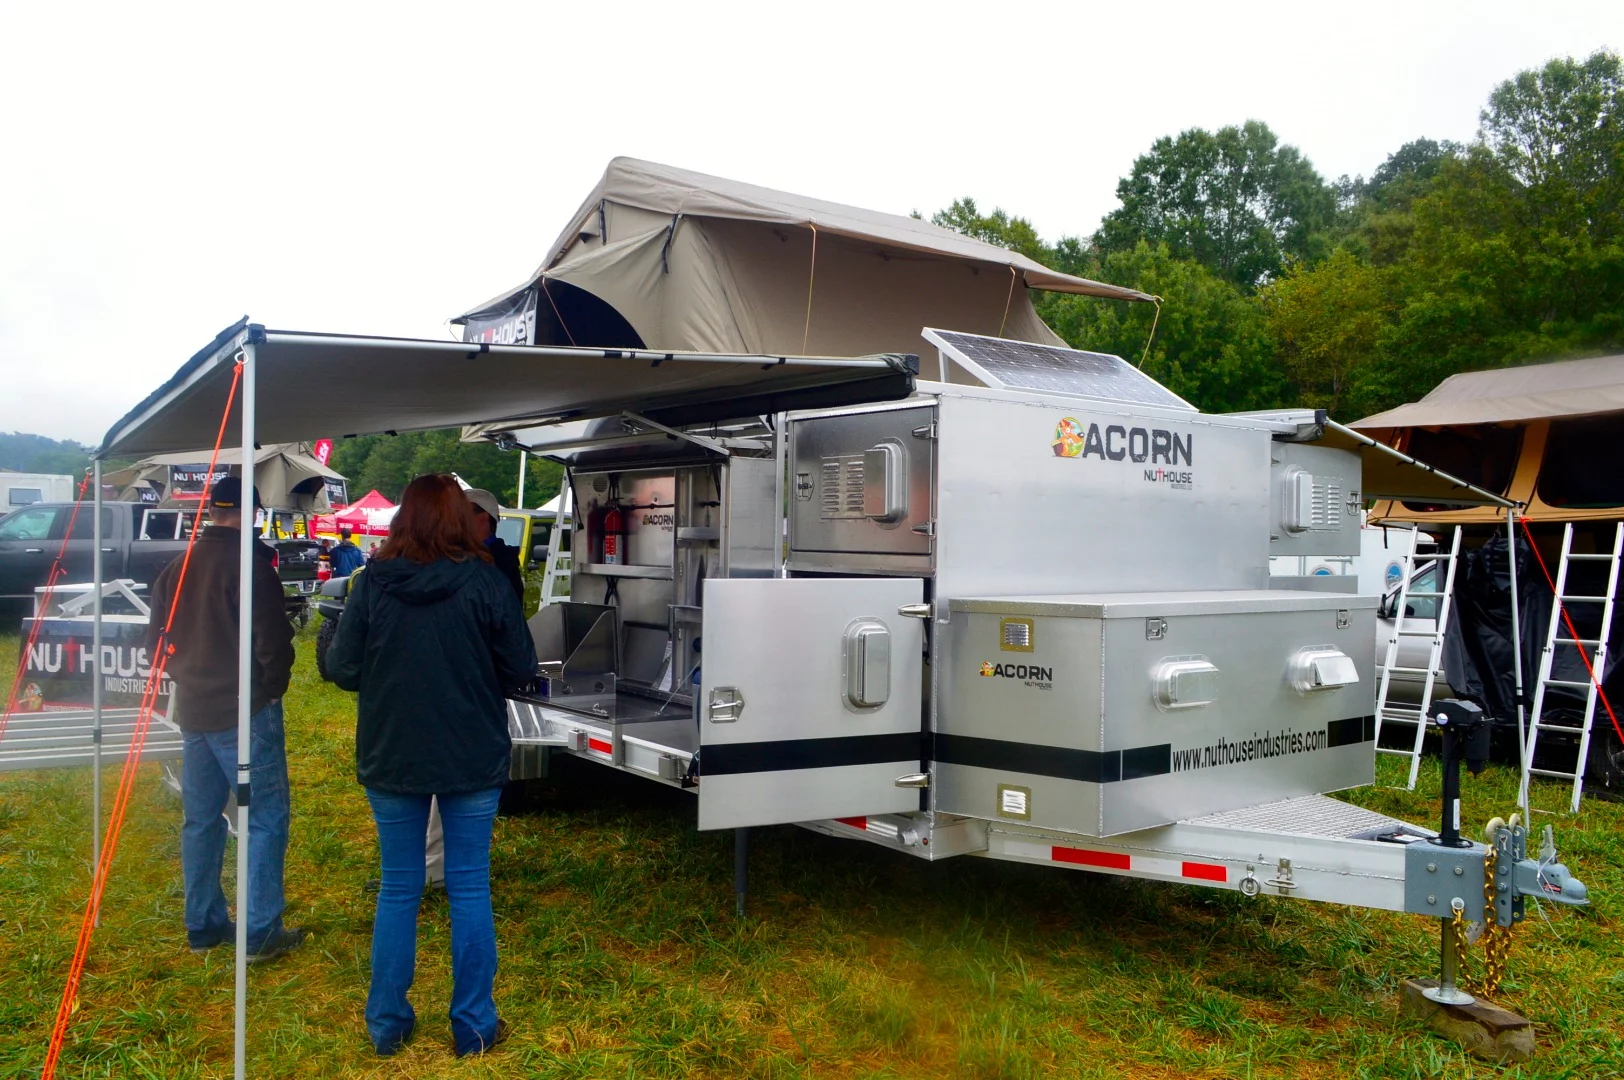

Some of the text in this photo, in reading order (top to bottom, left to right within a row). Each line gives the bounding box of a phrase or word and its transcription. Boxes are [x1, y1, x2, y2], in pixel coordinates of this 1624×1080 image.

[1082, 423, 1192, 466] ACORN
[1143, 468, 1193, 484] NUTHOUSE
[649, 514, 674, 526] ACORN
[27, 637, 171, 679] NUTHOUS
[993, 663, 1053, 681] ACORN
[105, 677, 154, 695] INDUSTRIES
[1173, 728, 1326, 772] www.nuthouseindustries.com
